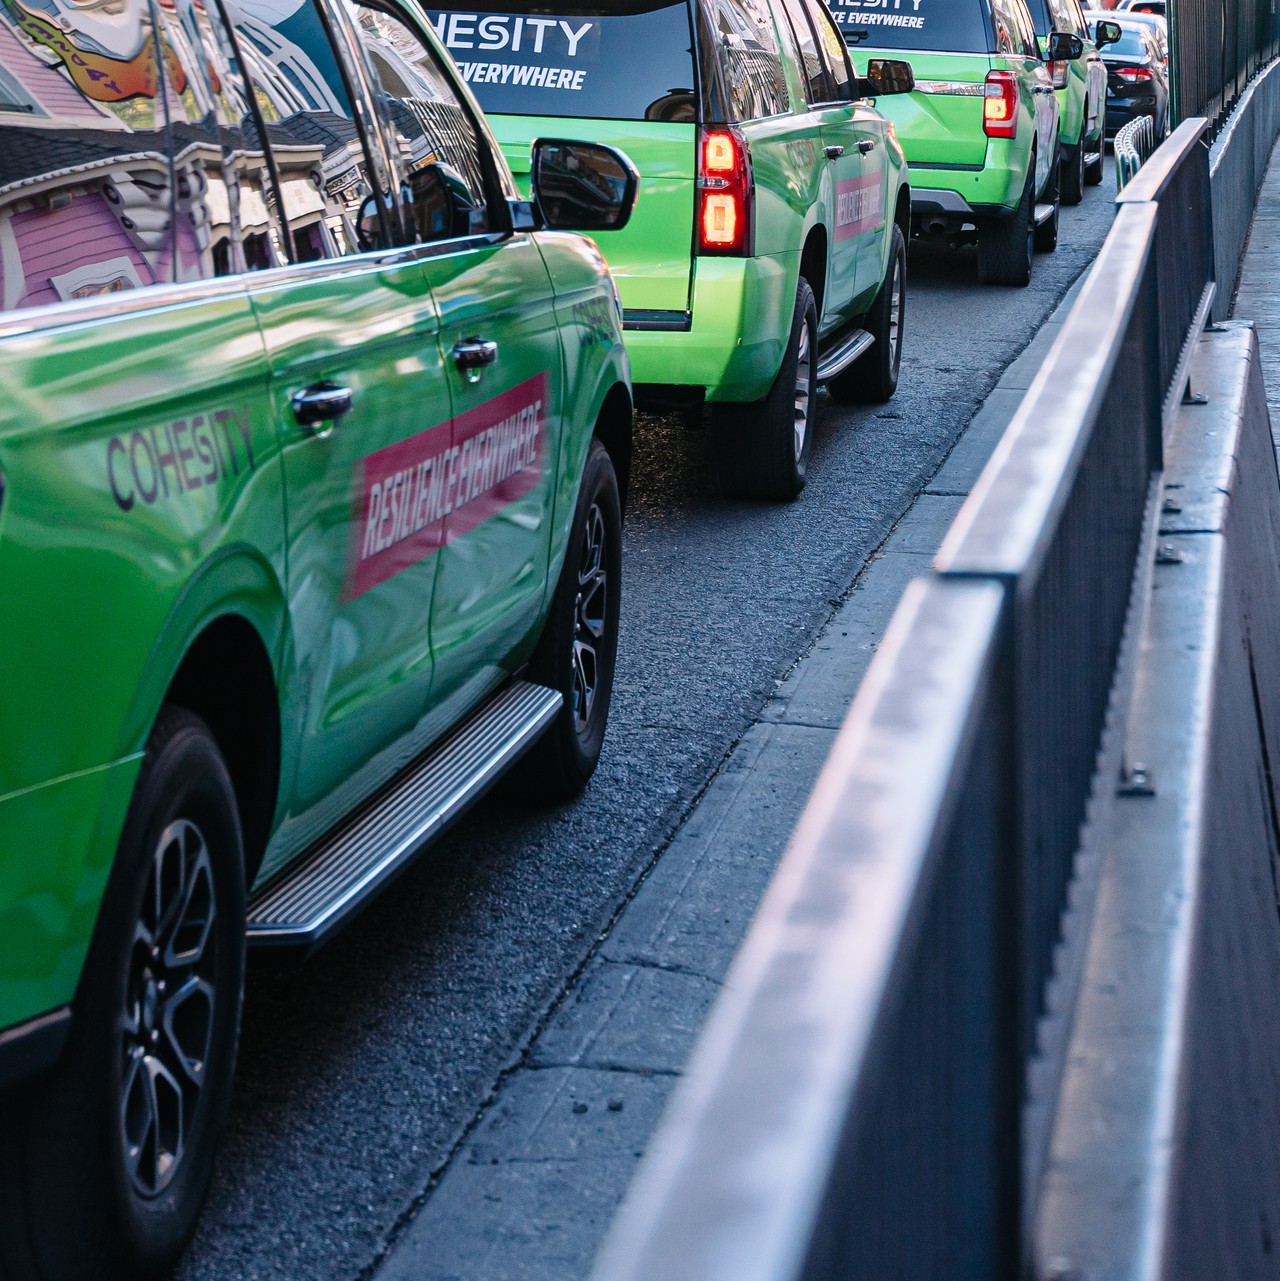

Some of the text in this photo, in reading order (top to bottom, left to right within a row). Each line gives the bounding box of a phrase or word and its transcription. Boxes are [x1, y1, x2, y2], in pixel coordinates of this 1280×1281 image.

[431, 13, 594, 57] HESITY
[848, 11, 925, 29] EVERYWHERE
[456, 61, 587, 91] EVERYWHERE
[105, 405, 256, 513] COHESITY
[361, 399, 543, 561] RESILIENCE EVERYWHERE
